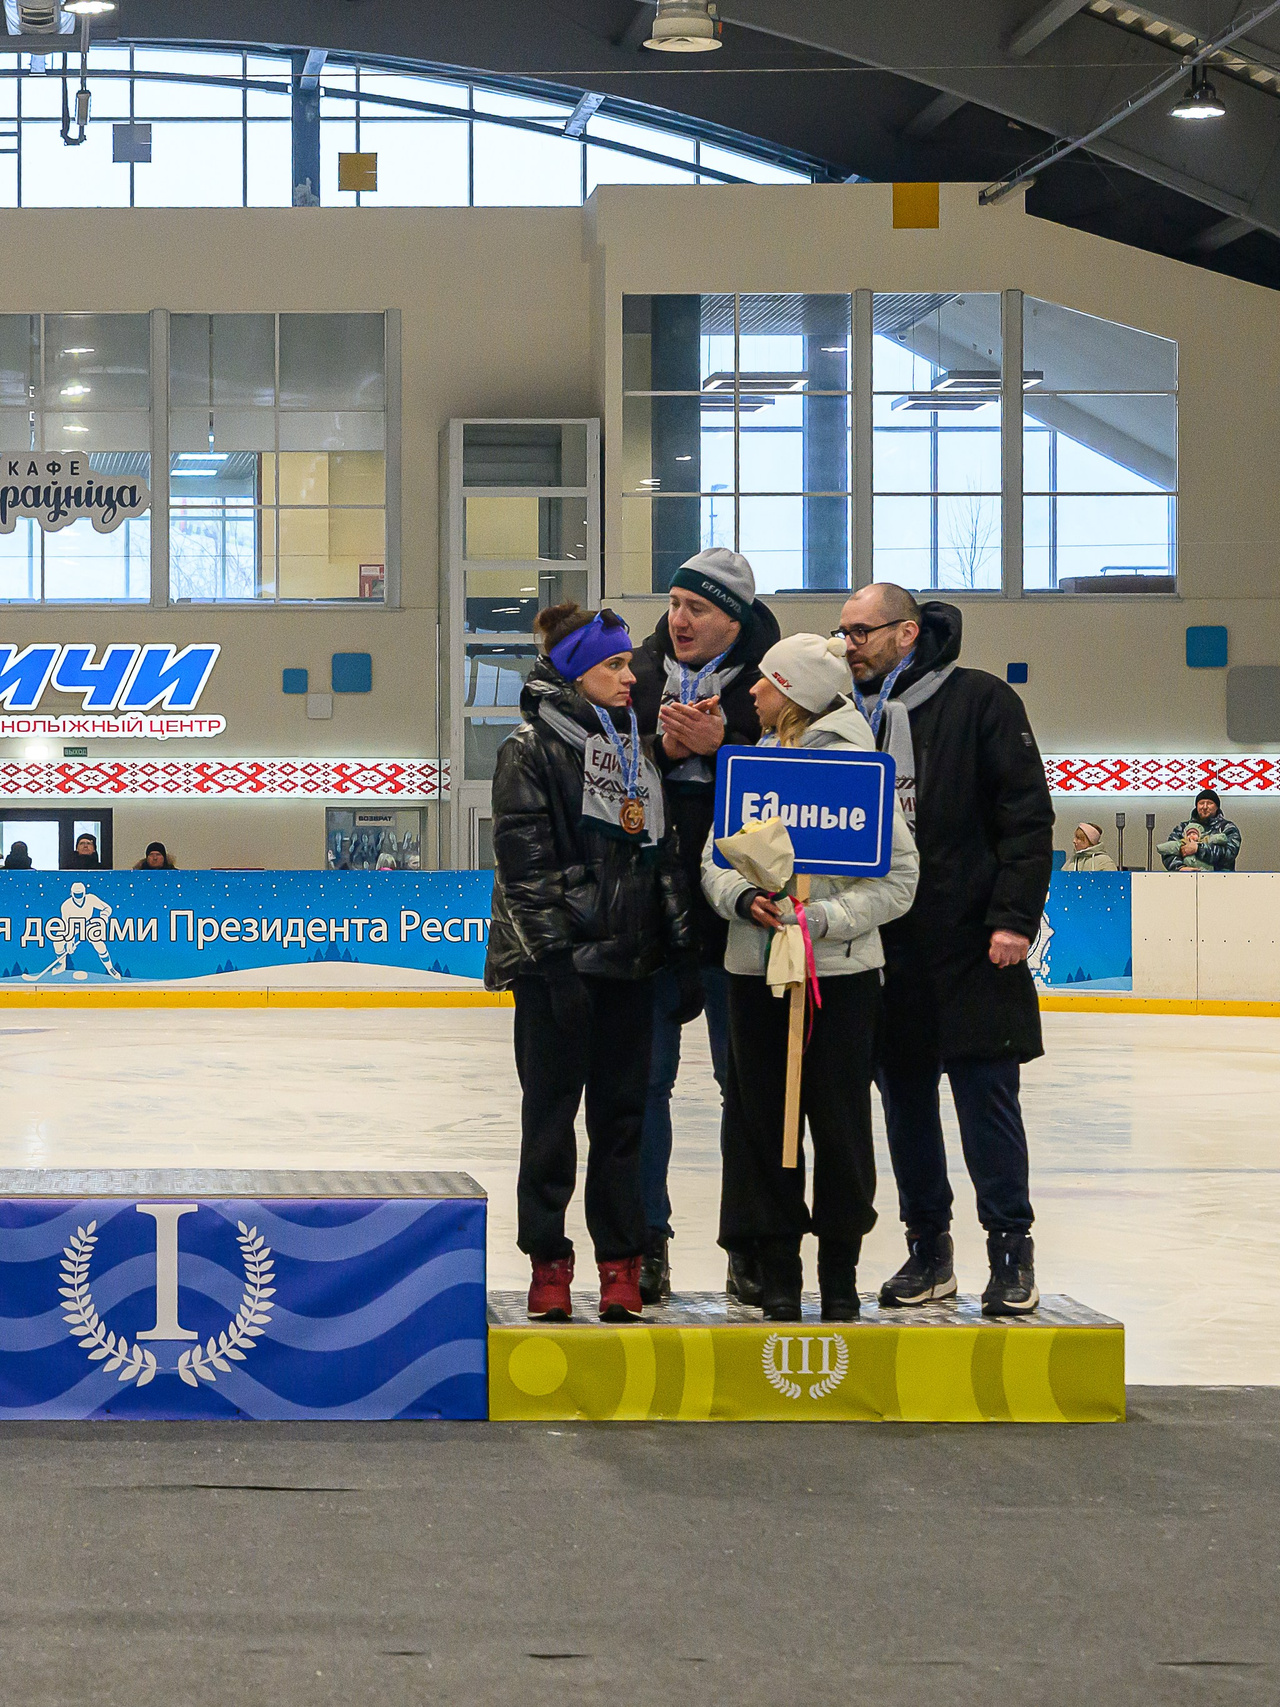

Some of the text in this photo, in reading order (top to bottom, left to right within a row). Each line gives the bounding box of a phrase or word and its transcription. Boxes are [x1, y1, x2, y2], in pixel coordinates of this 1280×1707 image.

[9, 460, 81, 476] КАФЕ
[150, 719, 221, 735] ЦЕНТР
[20, 916, 158, 949] делами
[169, 909, 389, 951] Президента
[136, 1204, 199, 1340] I
[777, 1336, 835, 1374] III
